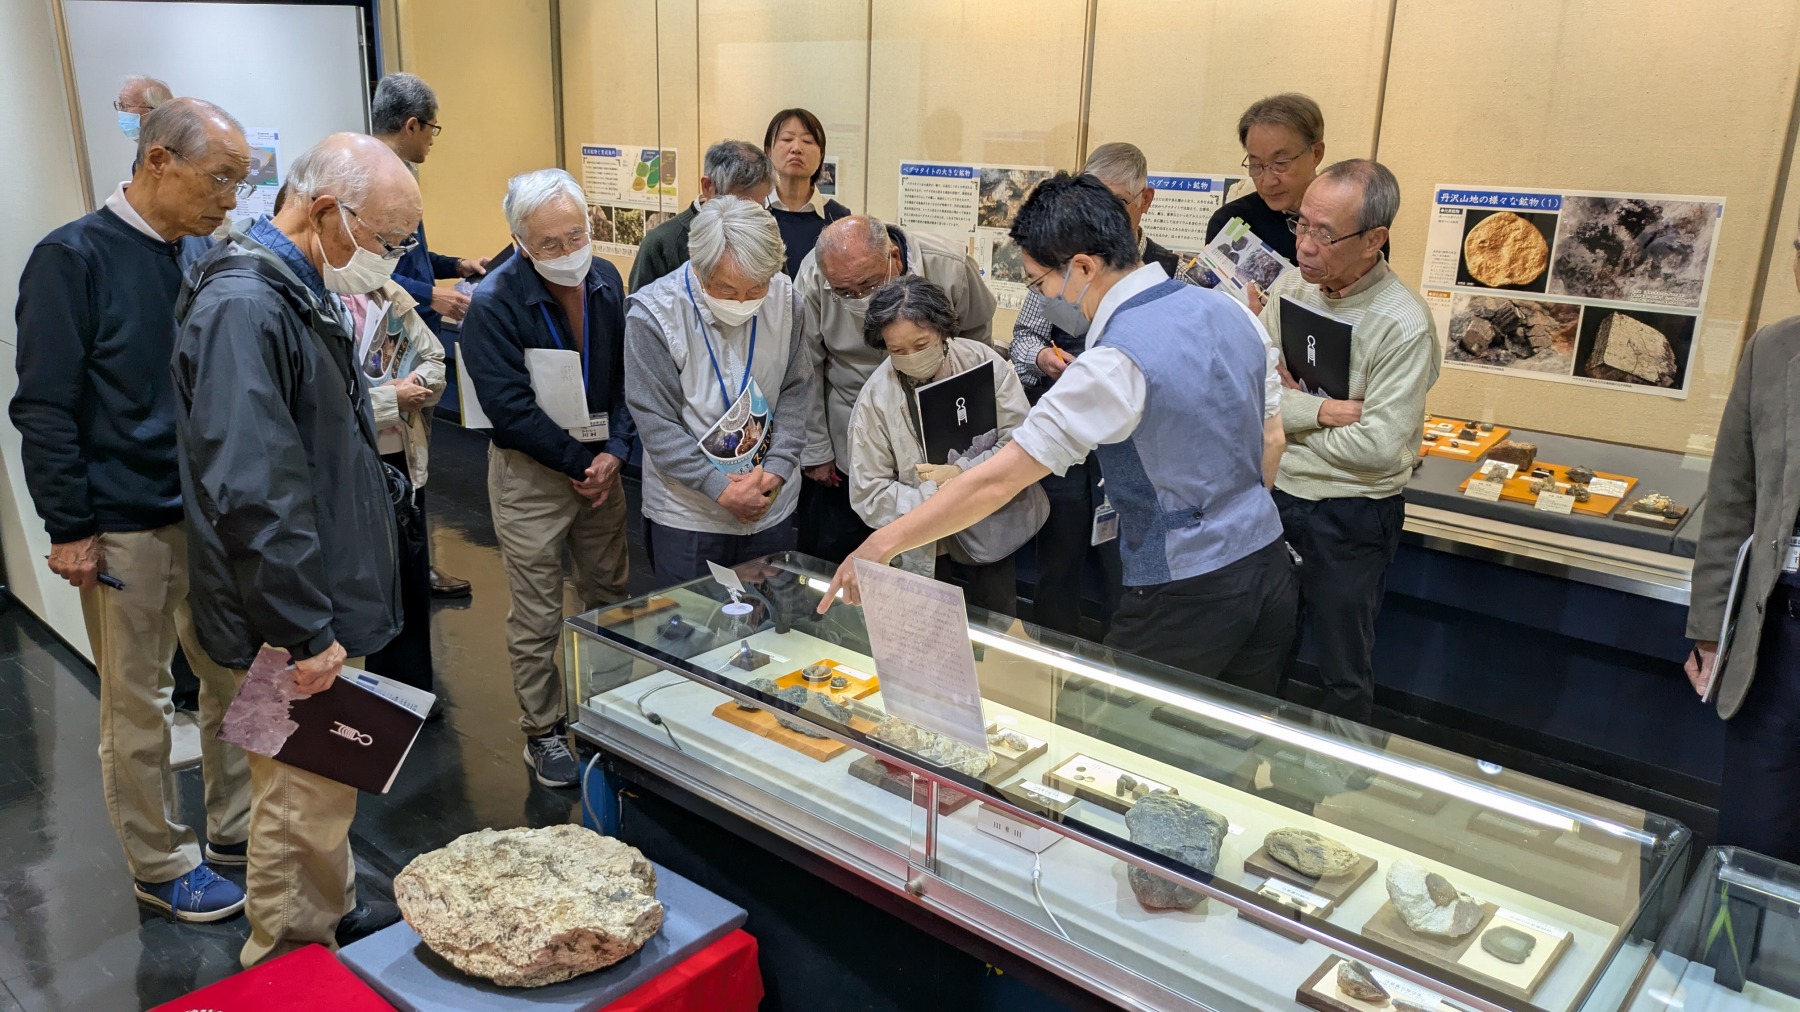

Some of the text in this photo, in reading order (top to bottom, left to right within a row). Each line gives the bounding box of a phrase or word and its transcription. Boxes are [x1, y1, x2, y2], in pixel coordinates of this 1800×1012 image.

[902, 165, 971, 178] ペグマタイトの大きな鉱物
[1148, 179, 1209, 190] ペグマタイト鉱物
